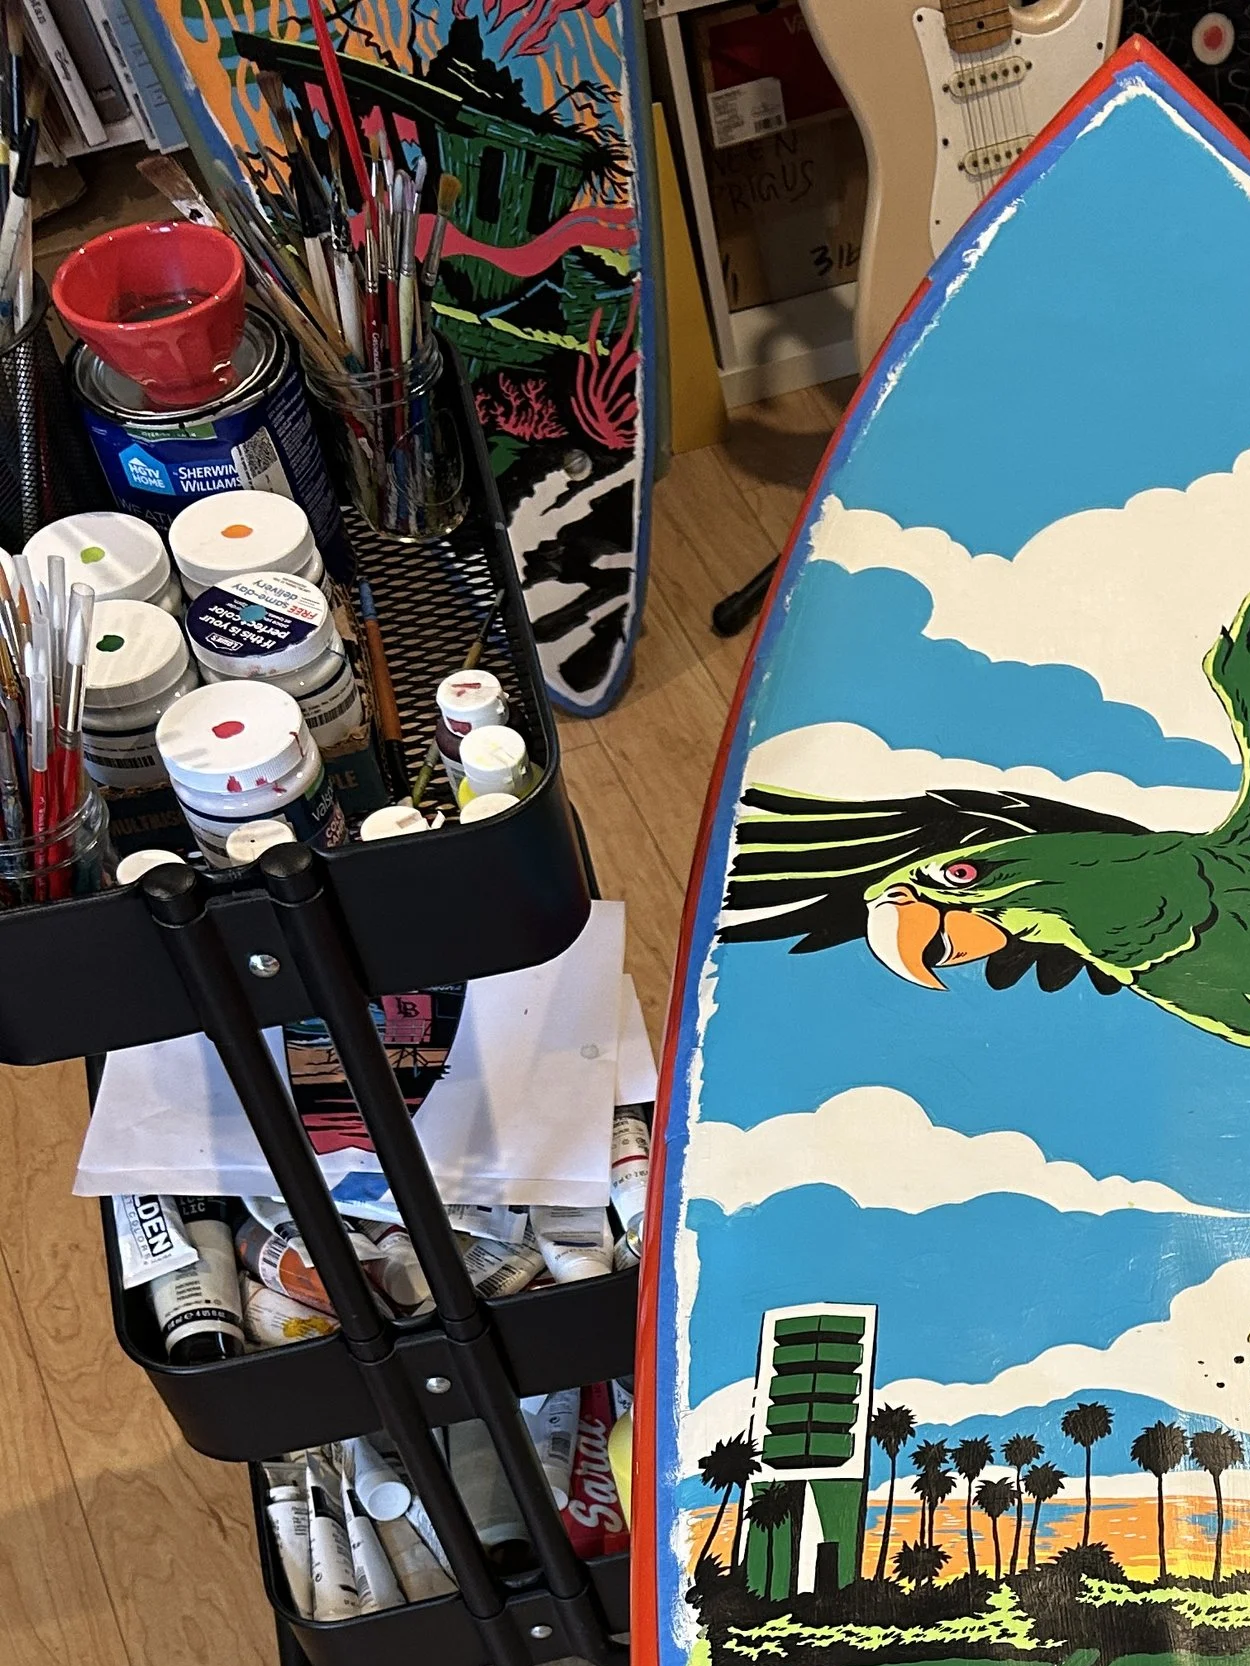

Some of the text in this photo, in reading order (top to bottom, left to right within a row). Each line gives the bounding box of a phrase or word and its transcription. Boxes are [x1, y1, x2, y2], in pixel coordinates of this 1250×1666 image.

[129, 461, 160, 480] HGTV
[131, 472, 166, 489] HOME
[231, 583, 289, 609] same-day
[252, 579, 298, 601] delivery
[208, 604, 241, 624] color
[287, 604, 318, 620] FREE
[198, 614, 277, 650] If this is your
